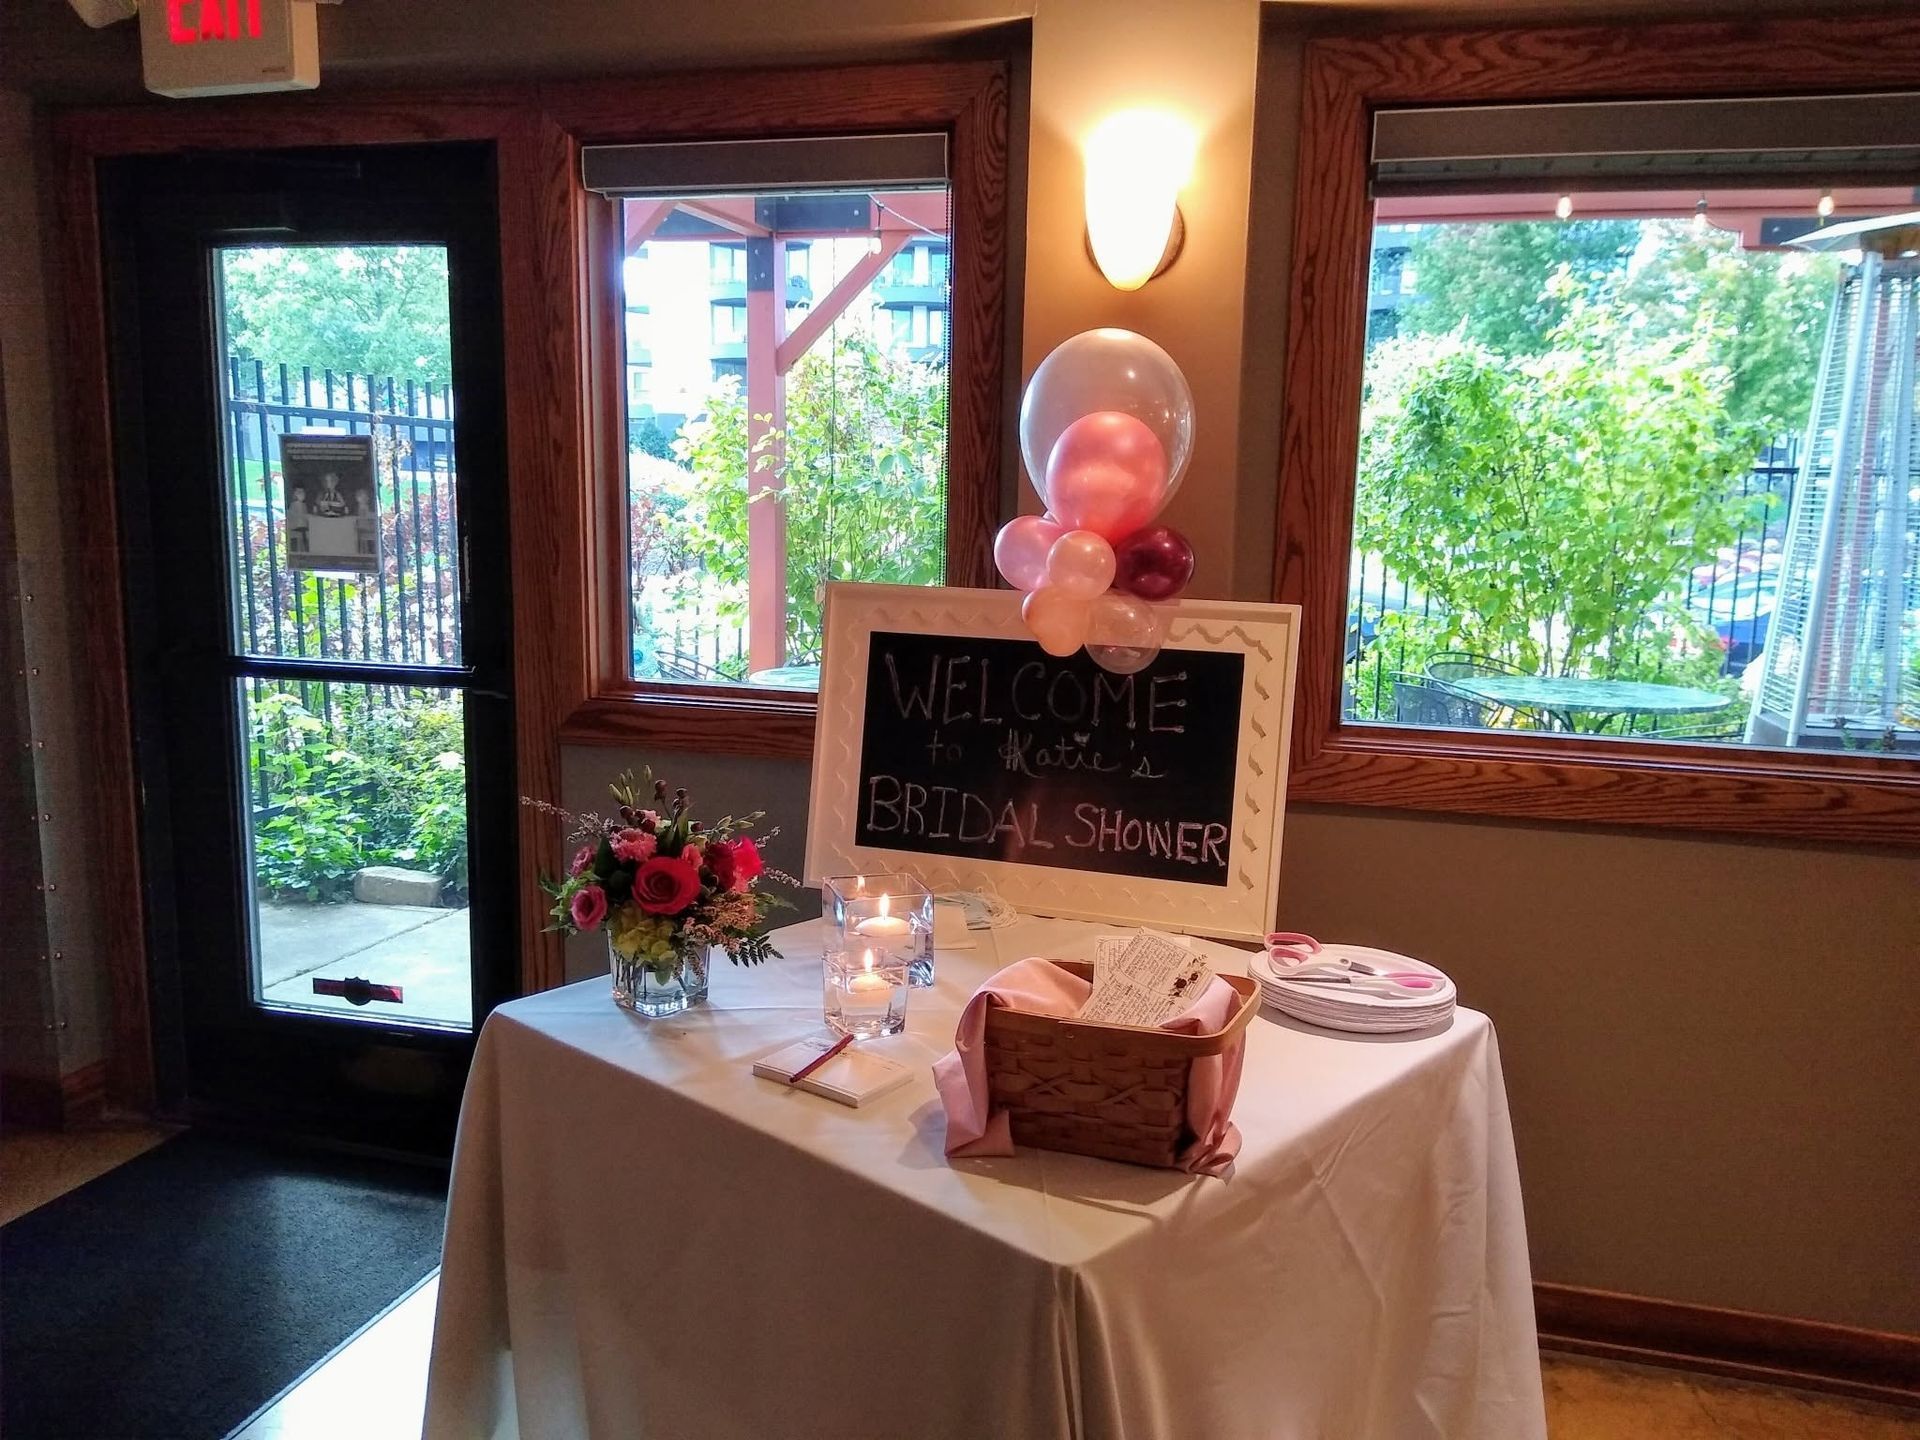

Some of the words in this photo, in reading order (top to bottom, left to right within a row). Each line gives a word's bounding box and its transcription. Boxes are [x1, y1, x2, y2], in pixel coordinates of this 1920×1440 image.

[885, 652, 1188, 733] WELCOME
[925, 729, 964, 766] to
[998, 727, 1168, 778] Katie's
[866, 774, 1054, 849] BRIDAL
[1065, 803, 1228, 867] SHOWER
